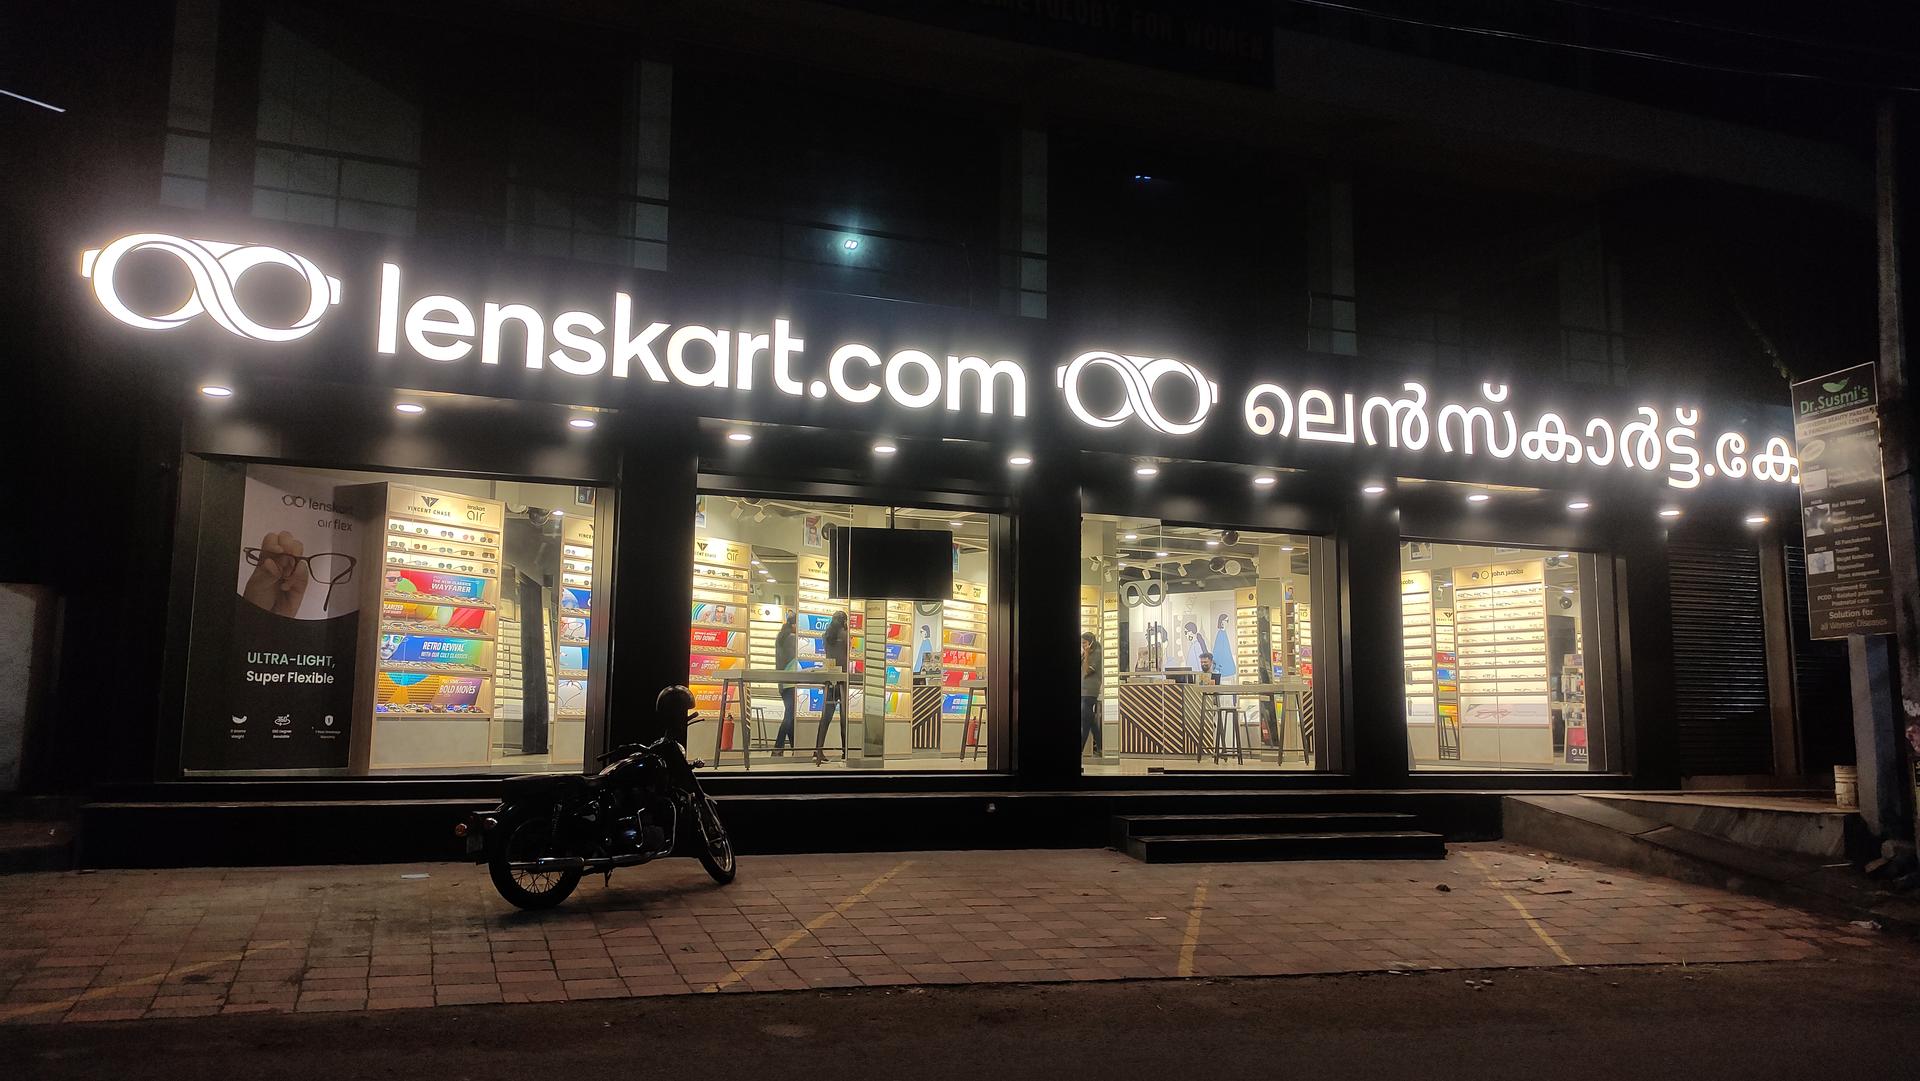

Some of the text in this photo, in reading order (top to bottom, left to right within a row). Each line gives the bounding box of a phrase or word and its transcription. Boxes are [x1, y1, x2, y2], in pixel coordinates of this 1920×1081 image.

[1182, 22, 1264, 61] WOMEN
[376, 262, 1027, 417] lenskart.com
[407, 505, 451, 517] VINCENT CHASE
[467, 510, 486, 521] air
[318, 519, 353, 532] air flex
[432, 583, 472, 593] WAYFARER
[1829, 608, 1874, 619] Solution for
[423, 641, 465, 652] RETRO REVIVAL
[247, 652, 335, 669] ULTRA-LIGHT,
[246, 671, 335, 686] Super Flexible
[455, 685, 477, 695] MOVES
